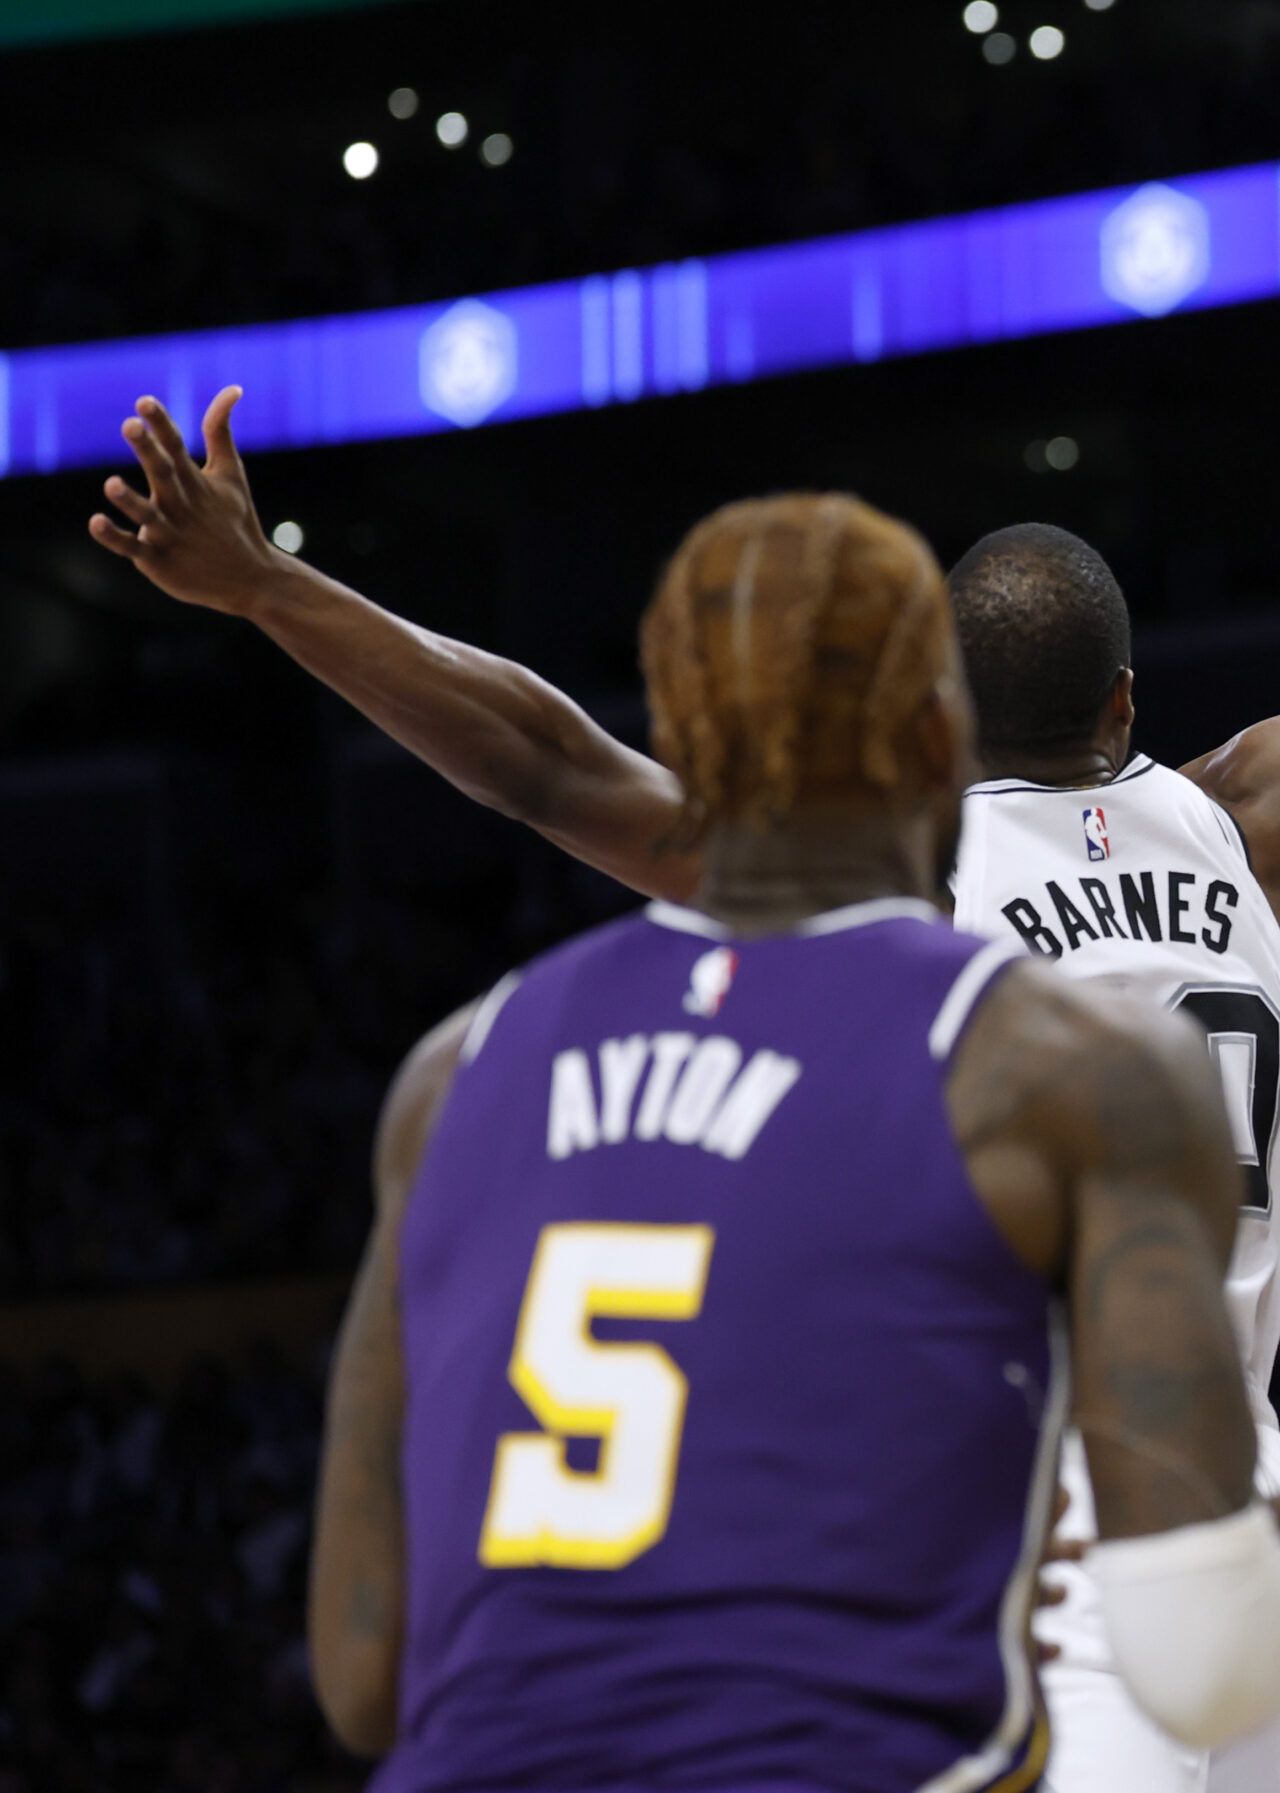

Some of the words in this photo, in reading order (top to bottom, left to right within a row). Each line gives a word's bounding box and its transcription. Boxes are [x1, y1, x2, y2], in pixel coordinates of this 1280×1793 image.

[1001, 871, 1239, 961] BARNES
[546, 1032, 801, 1161] AYTON
[478, 1220, 715, 1570] 5
